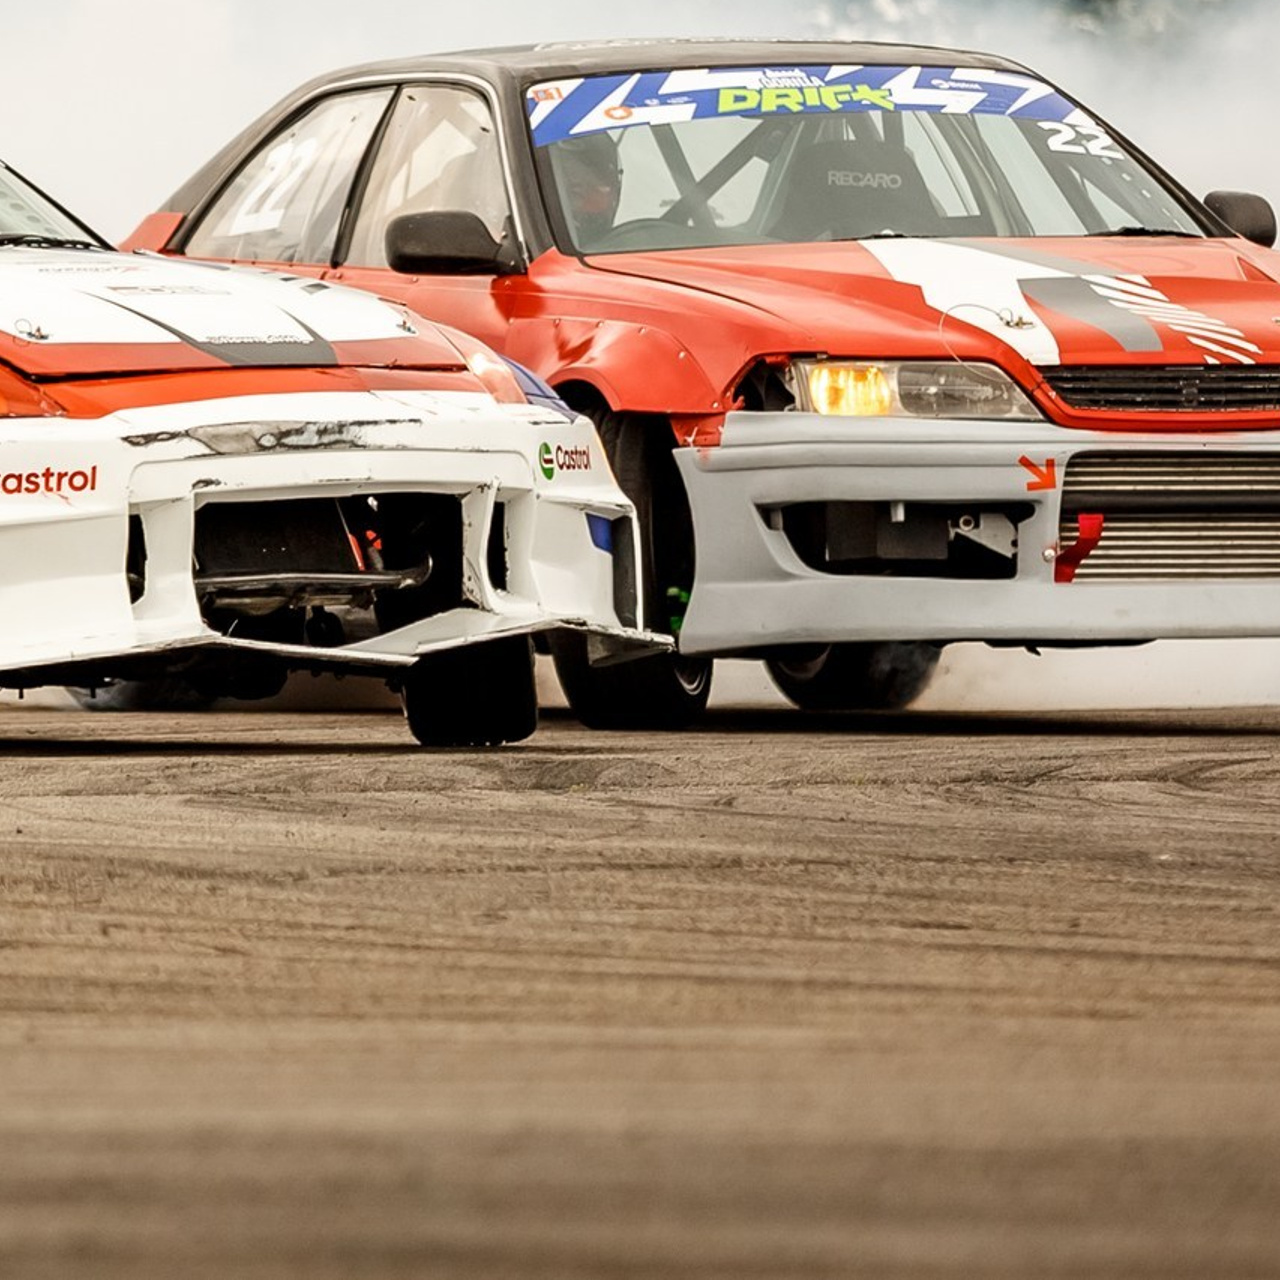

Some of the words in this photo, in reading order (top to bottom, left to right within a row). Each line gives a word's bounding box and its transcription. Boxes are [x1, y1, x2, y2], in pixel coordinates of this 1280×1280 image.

[1037, 121, 1125, 160] 22
[228, 138, 319, 236] 22
[827, 171, 902, 189] RECARO
[556, 444, 591, 471] Castrol
